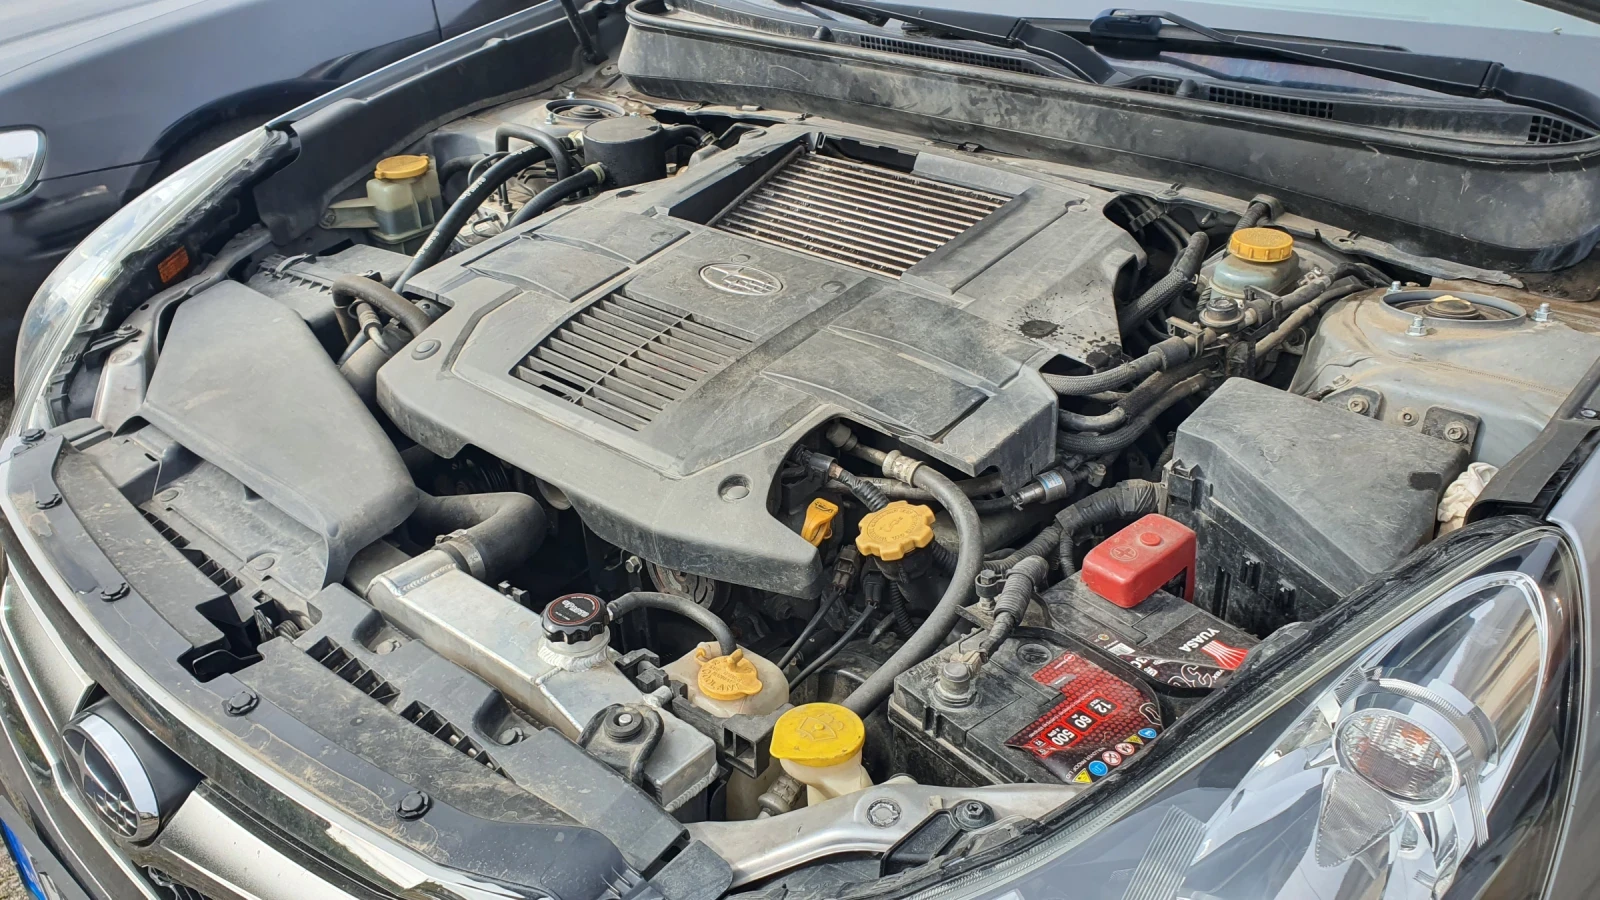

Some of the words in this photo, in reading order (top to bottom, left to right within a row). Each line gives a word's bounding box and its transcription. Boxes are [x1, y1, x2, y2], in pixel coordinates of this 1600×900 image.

[1178, 627, 1220, 653] YUASA
[1094, 700, 1112, 713] 12
[1074, 715, 1092, 729] 60
[1051, 729, 1075, 746] 500
